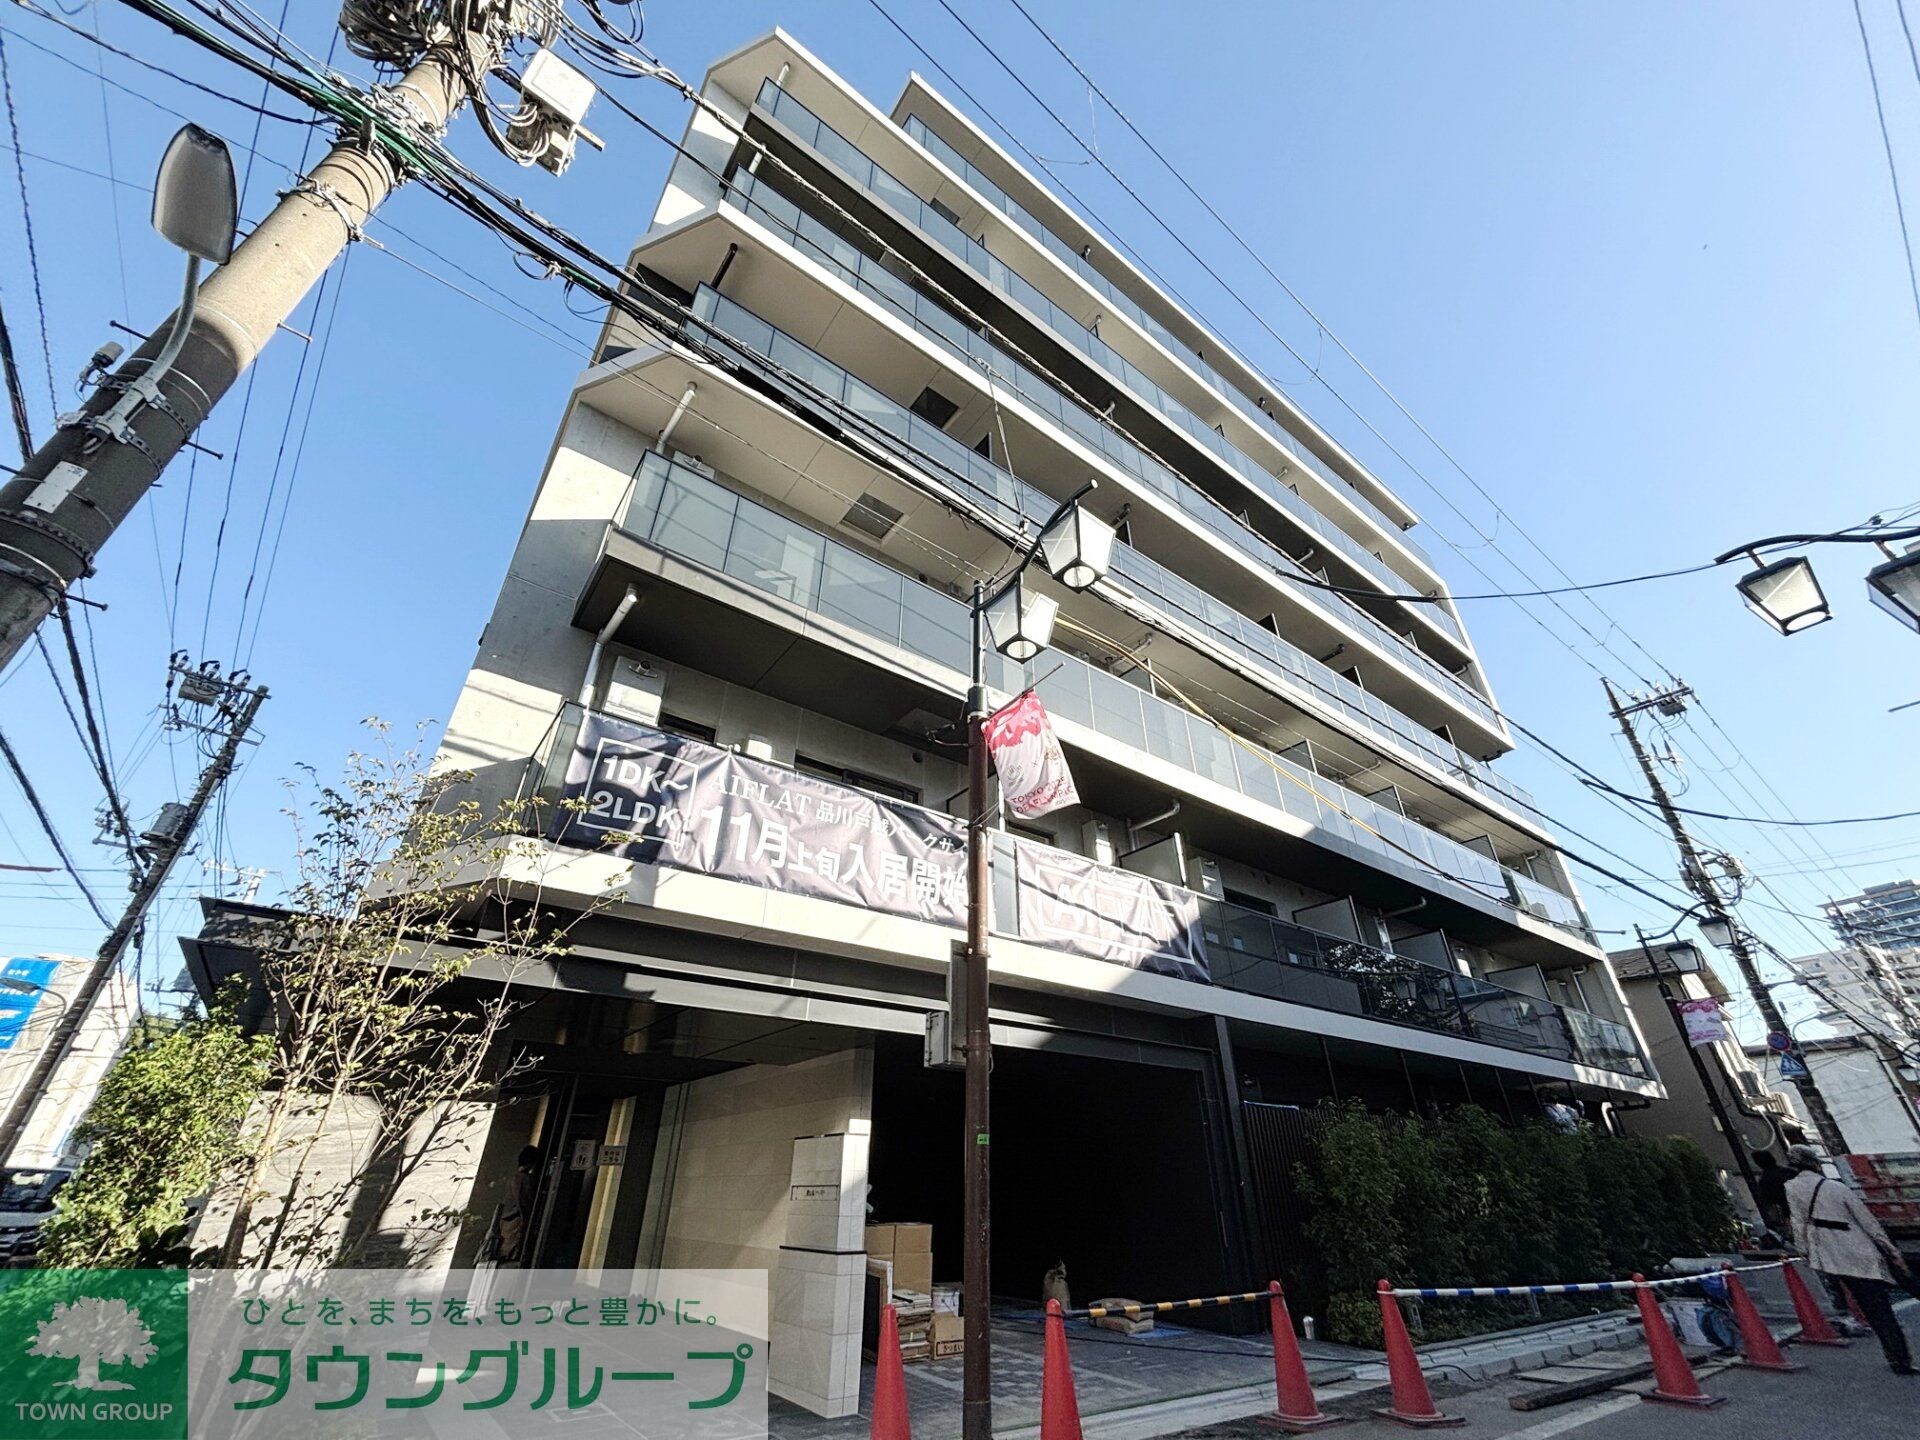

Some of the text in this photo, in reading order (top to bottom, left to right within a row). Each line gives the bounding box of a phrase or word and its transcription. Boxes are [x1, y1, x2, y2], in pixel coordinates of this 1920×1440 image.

[592, 790, 681, 833] 2LDK
[708, 774, 812, 816] AIFLAT
[1011, 786, 1044, 804] TOKYO
